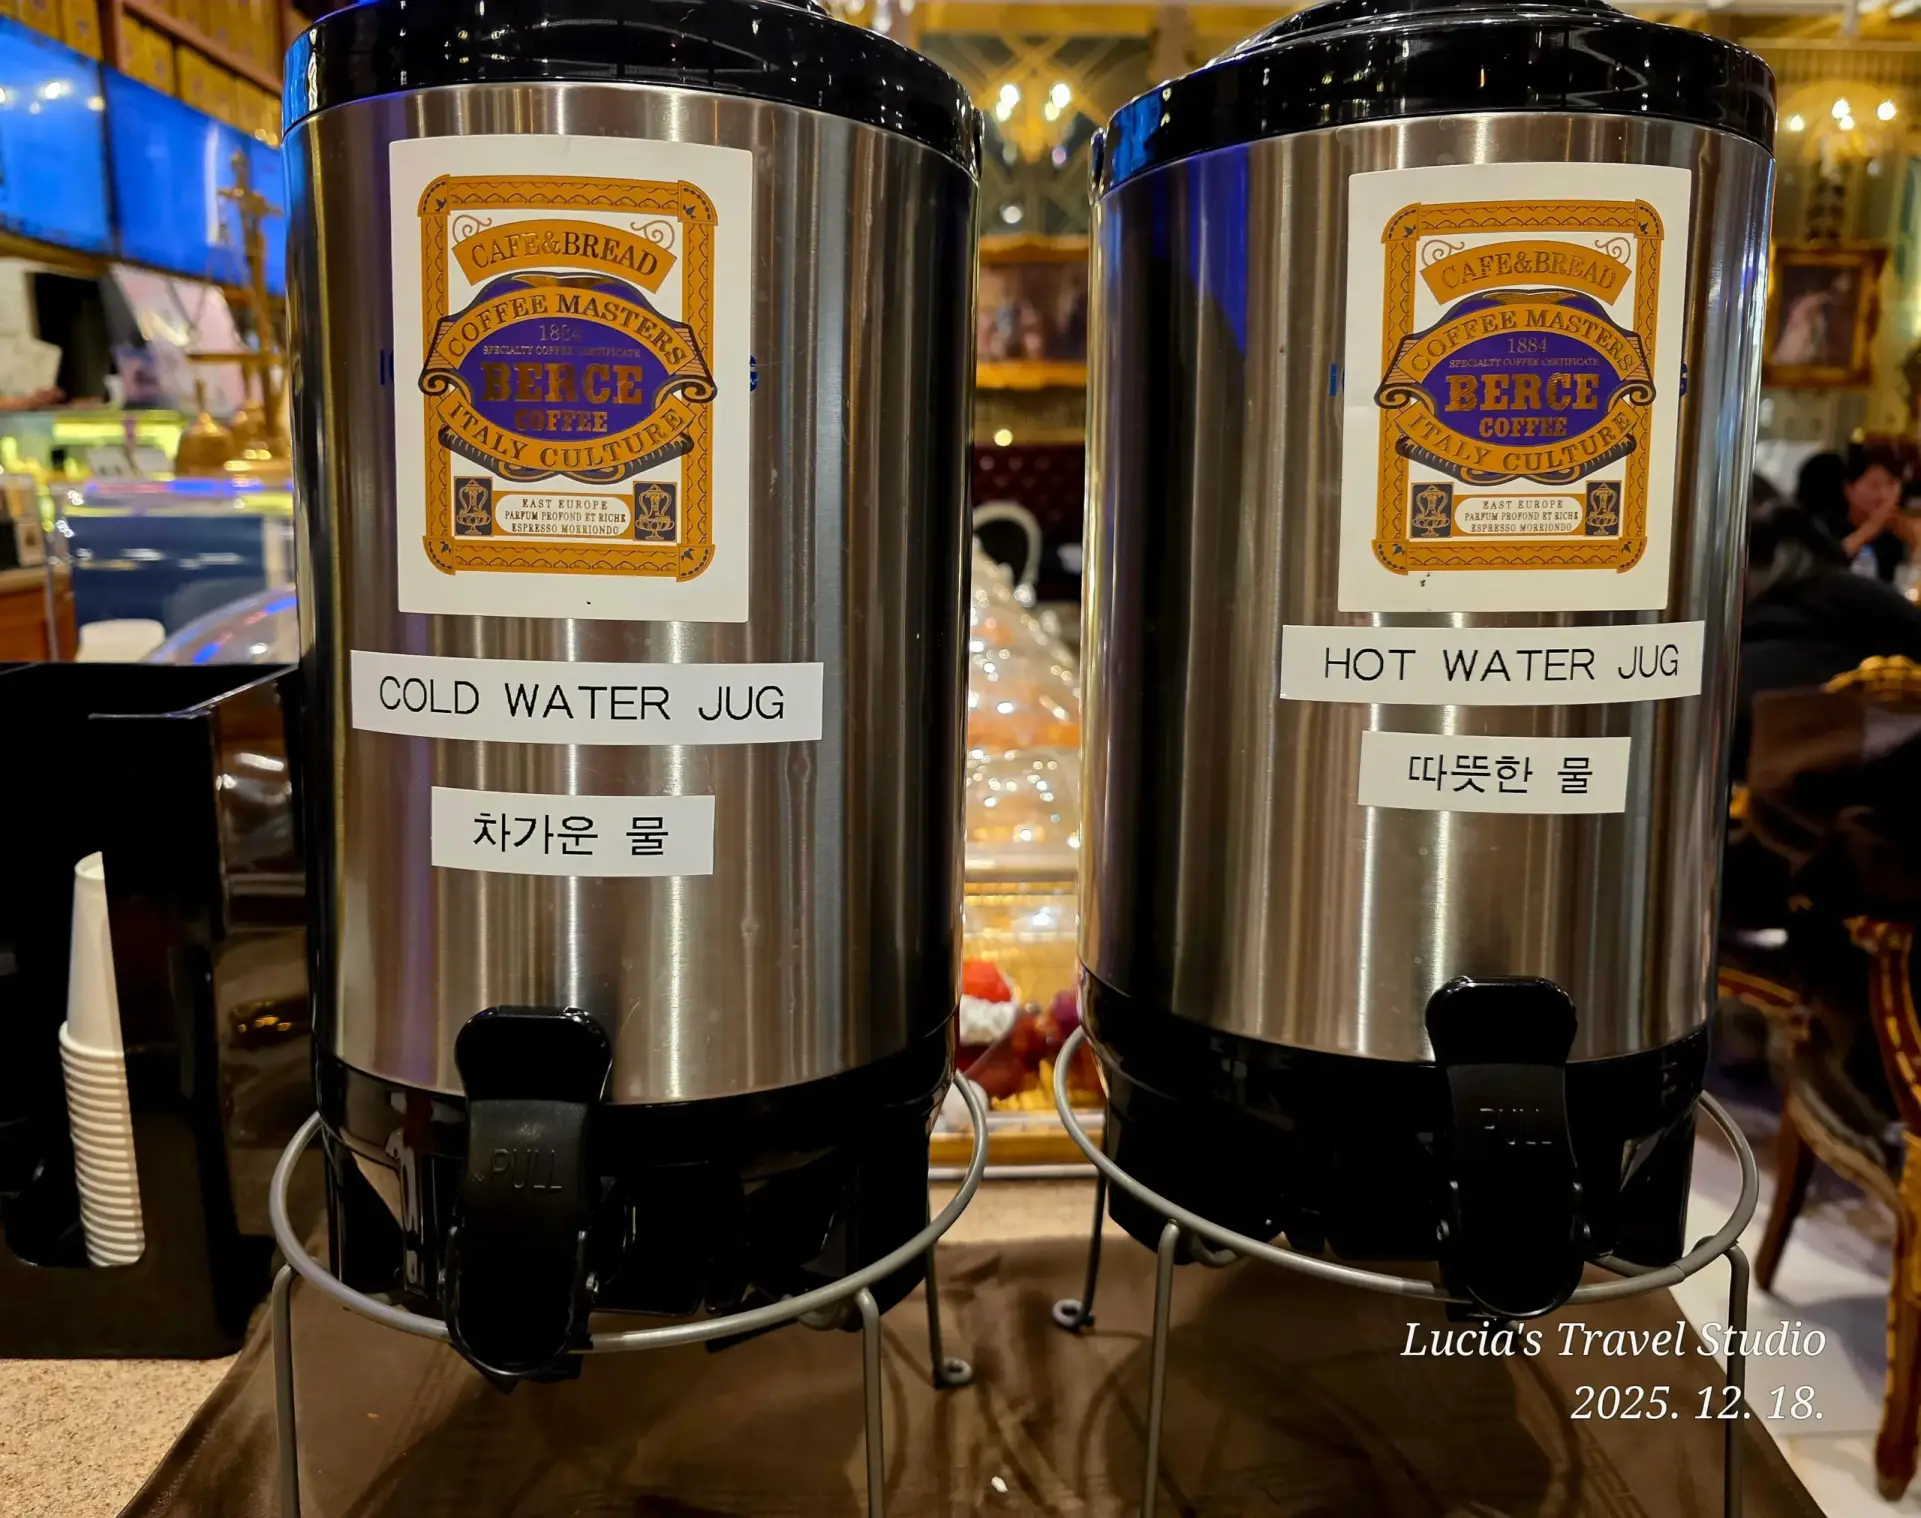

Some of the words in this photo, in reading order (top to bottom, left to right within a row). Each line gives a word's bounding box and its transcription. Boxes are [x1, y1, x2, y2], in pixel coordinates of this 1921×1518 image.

[471, 231, 658, 276] CAFE&BREAD
[1441, 250, 1617, 290] CAFE&BREAD
[448, 294, 548, 358] COFFEE
[556, 294, 688, 365] MASTERS
[1411, 310, 1517, 373] COFFEE
[1524, 309, 1636, 372] MASTERS
[1507, 337, 1549, 354] 1884
[483, 345, 533, 356] SPECIALTY
[578, 347, 641, 358] ERTIFICATE
[1449, 358, 1501, 368] SPECIALTY
[1503, 357, 1538, 366] COFFEE
[1541, 357, 1600, 367] CERTIFICATE
[480, 362, 643, 405] BERCE
[1444, 372, 1600, 412] BERCE
[450, 401, 528, 461] ITALY
[539, 407, 684, 469] CULTURE
[514, 409, 608, 432] COFFEE
[1479, 417, 1567, 438] COFFEE
[1408, 413, 1492, 466] ITALY
[1502, 411, 1631, 471] CULTURE
[505, 510, 538, 520] PARFUM
[542, 511, 582, 521] PROFOND
[585, 513, 596, 522] ET
[598, 513, 626, 523] RICHE
[522, 498, 552, 508] EAST
[558, 499, 608, 510] EUROPE
[1464, 512, 1498, 521] PARFUM
[1501, 511, 1540, 521] PROFOND
[1542, 511, 1552, 520] ET
[1554, 511, 1578, 520] RICHE
[1483, 500, 1512, 510] EAST
[1518, 499, 1563, 509] EUROPE
[511, 523, 558, 533] ESPRESSO
[561, 525, 619, 535] MORRIONDO
[1471, 523, 1516, 532] ESPRESSO
[1520, 523, 1572, 532] MORRIONDO
[1324, 647, 1416, 681] HOT
[1442, 649, 1596, 682] WATER
[1617, 644, 1679, 680] JUG
[379, 675, 480, 715] COLD
[504, 682, 671, 721] WATER
[698, 685, 784, 721] JUG
[1408, 754, 1533, 795] 따뜻한
[1557, 756, 1593, 794] 물
[473, 812, 599, 856] 차가운
[626, 816, 669, 856] 물
[492, 1148, 562, 1189] PULL
